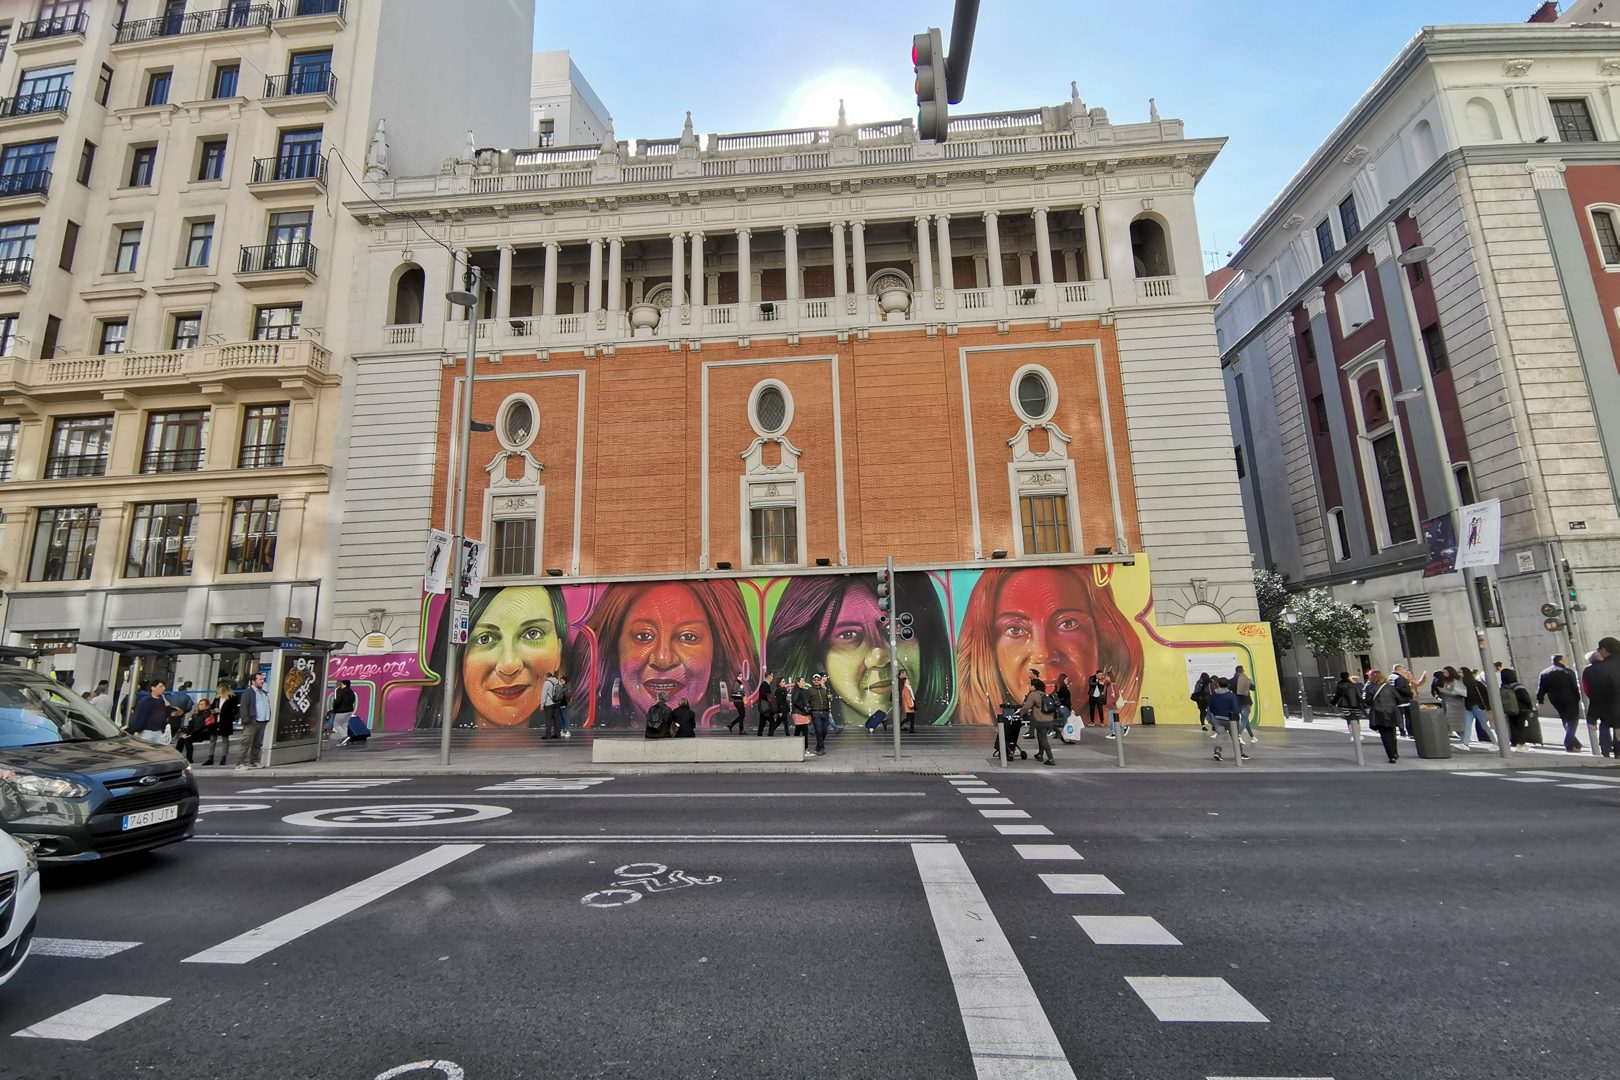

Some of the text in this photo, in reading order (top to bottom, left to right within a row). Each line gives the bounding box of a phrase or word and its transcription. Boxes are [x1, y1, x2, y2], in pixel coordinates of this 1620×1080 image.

[115, 629, 141, 639] PUNT
[130, 807, 175, 828] 7461 JTY
